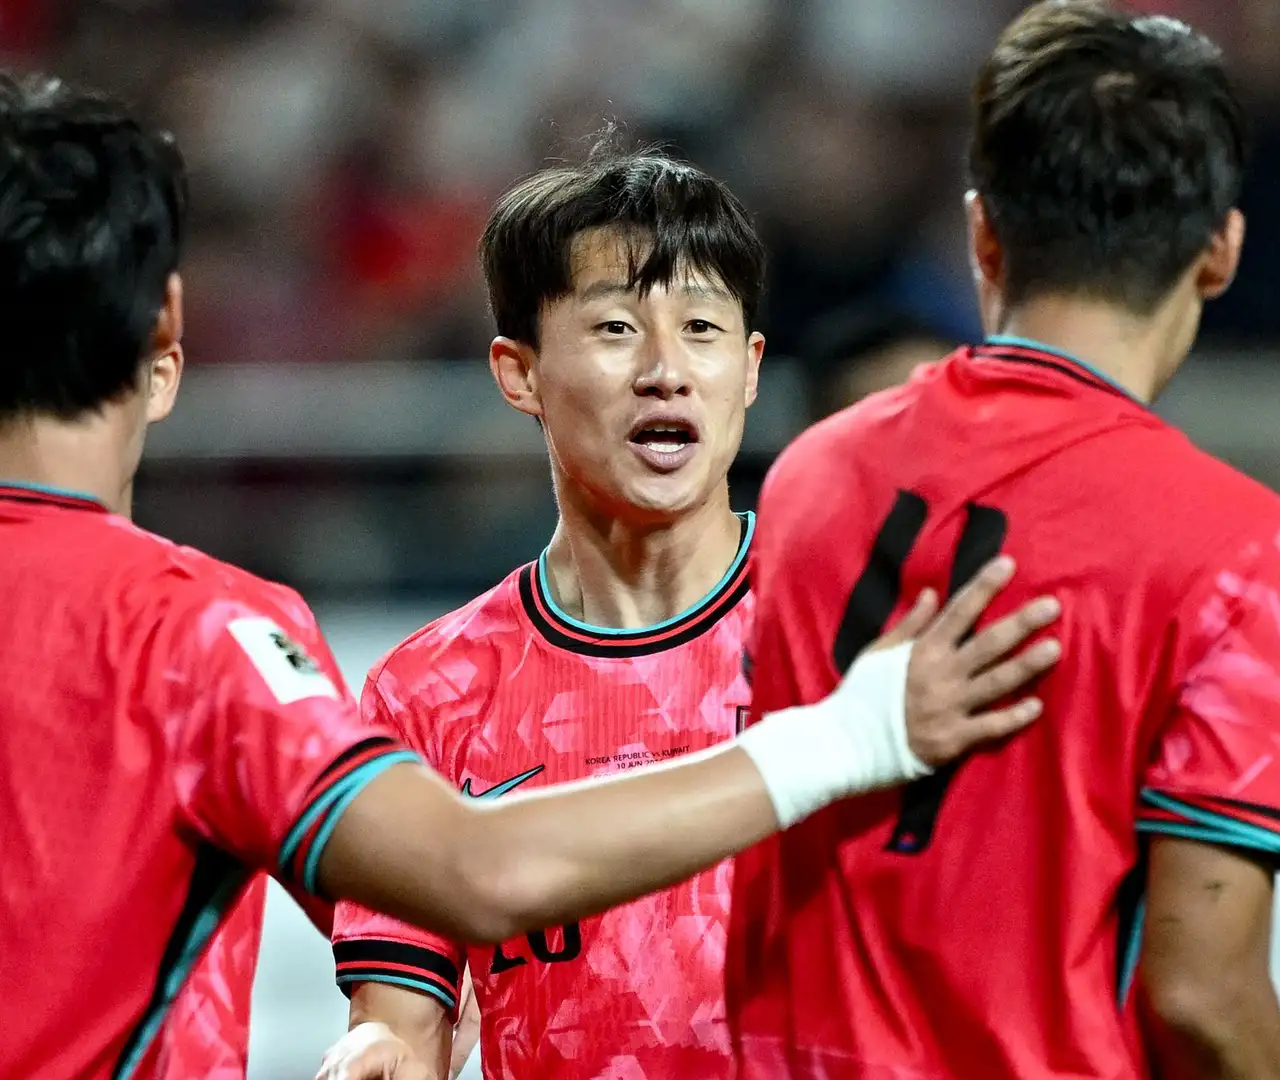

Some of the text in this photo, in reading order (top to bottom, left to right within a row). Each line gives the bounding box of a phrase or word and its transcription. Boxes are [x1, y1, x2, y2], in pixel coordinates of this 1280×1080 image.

[585, 755, 611, 766] KOREA
[613, 750, 650, 762] REPUBLIC
[661, 745, 690, 758] KUWAIT
[628, 760, 643, 769] JUN
